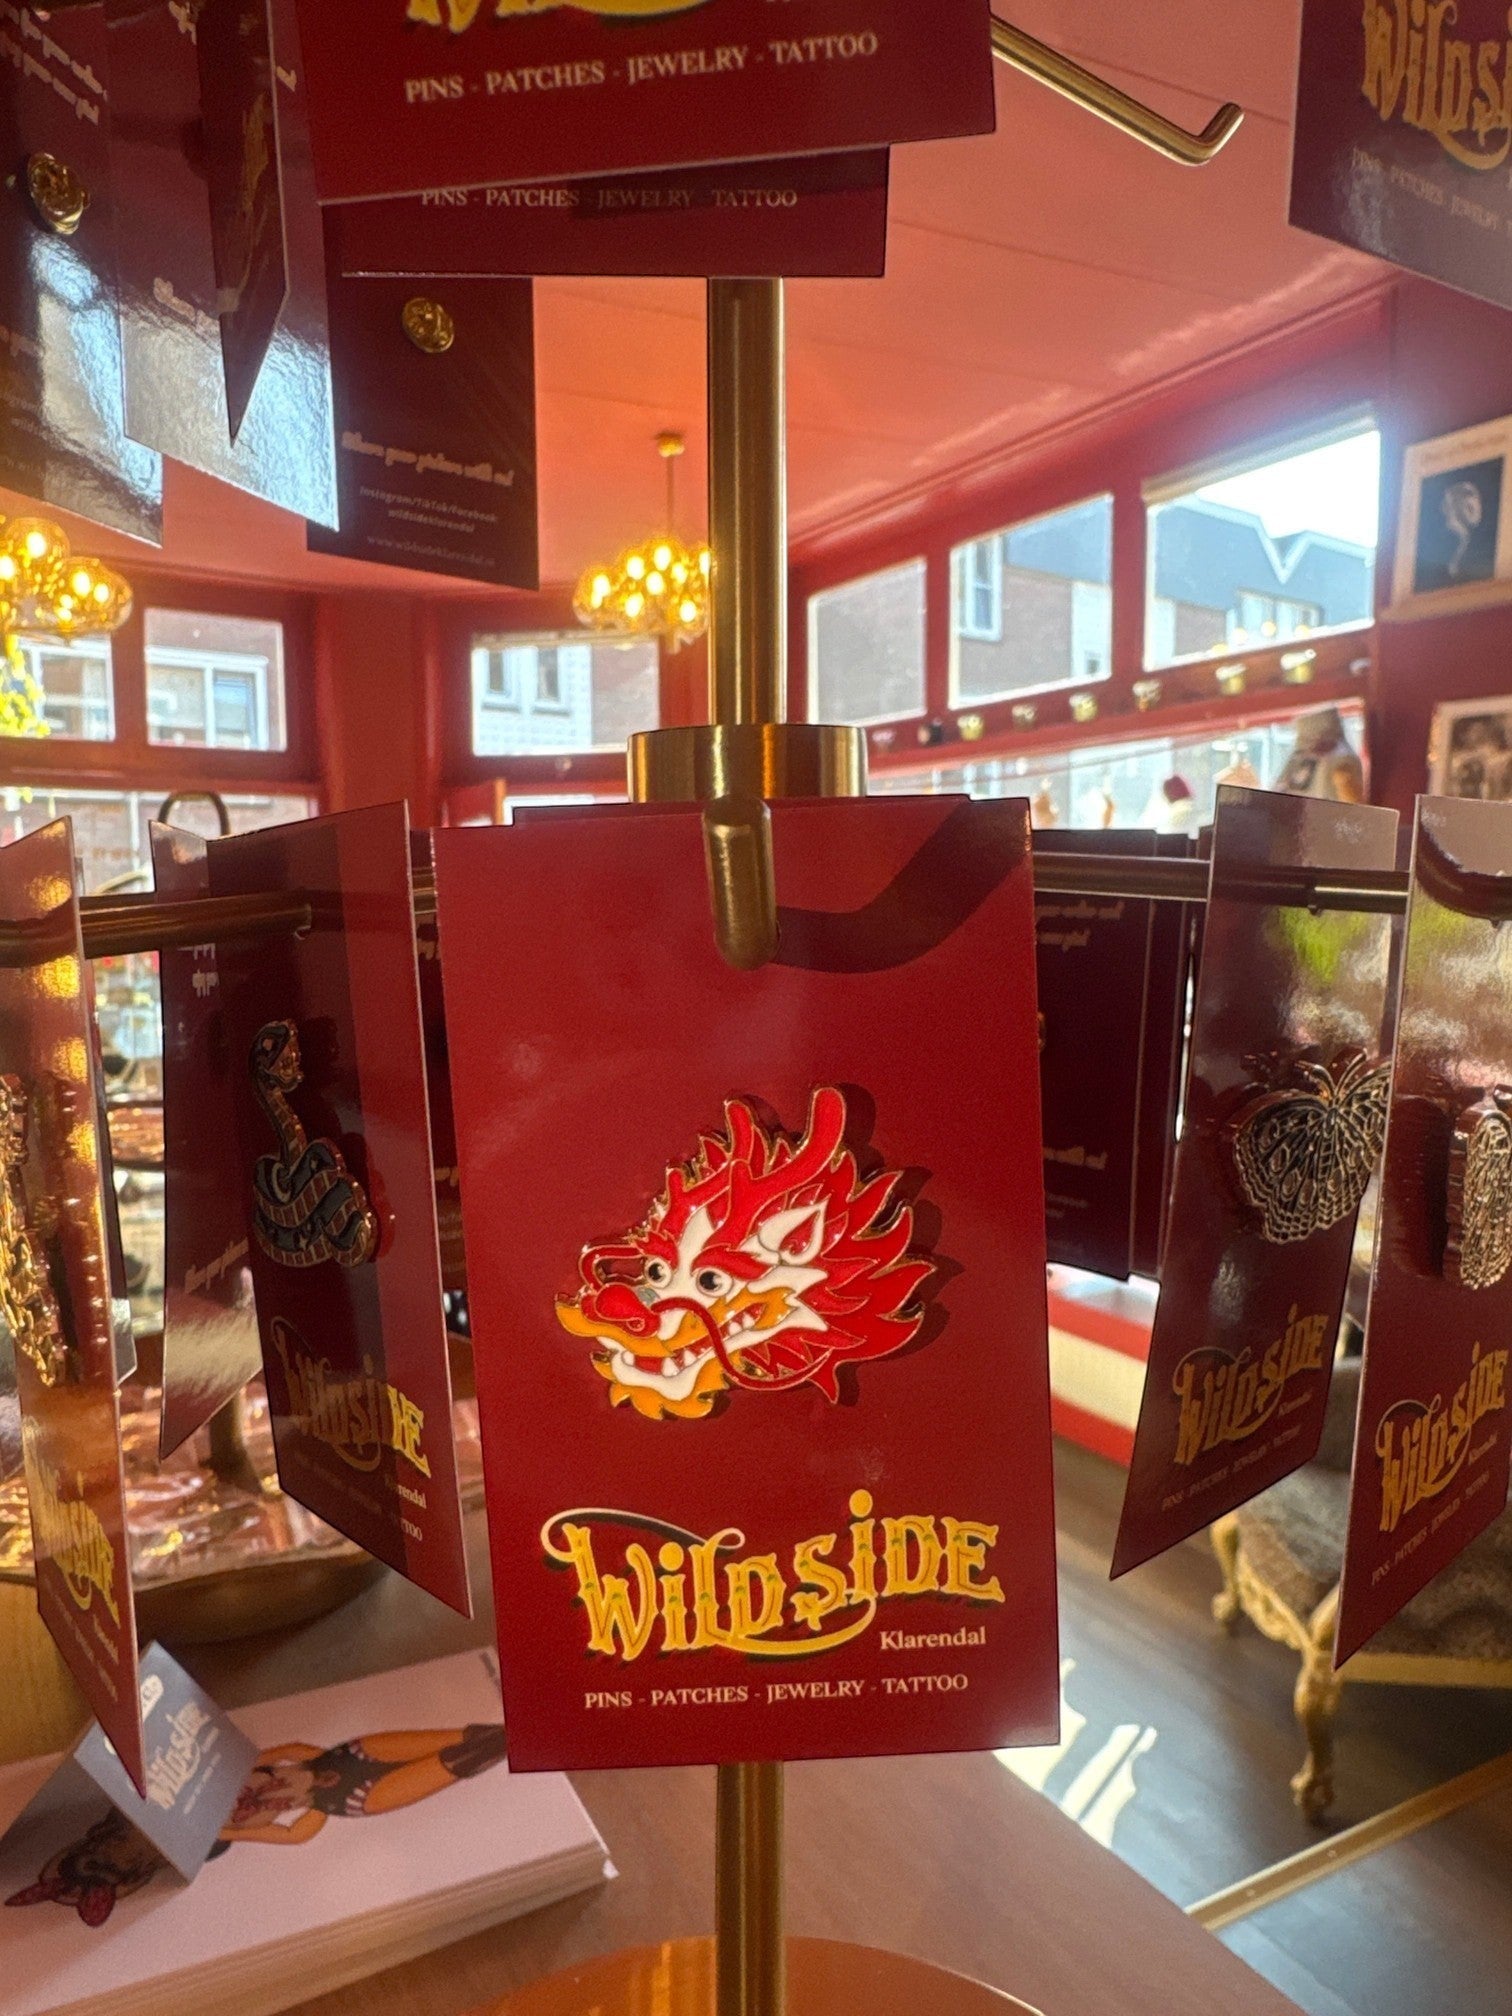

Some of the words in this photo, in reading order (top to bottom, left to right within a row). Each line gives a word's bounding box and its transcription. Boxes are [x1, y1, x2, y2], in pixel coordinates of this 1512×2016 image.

[405, 78, 463, 103] PINS
[486, 61, 605, 96] PATCHES
[627, 46, 748, 85] JEWELRY
[769, 32, 878, 65] TATTOO
[422, 189, 467, 207] PINS
[485, 189, 579, 207] PATCHES
[598, 190, 693, 209] JEWELRY
[714, 189, 797, 208] TATTOO
[880, 1626, 986, 1651] Klarendal
[584, 1691, 633, 1709] PINS
[650, 1686, 748, 1707] PATCHES
[766, 1680, 865, 1704] JEWELRY
[882, 1674, 968, 1696] TATTOO
